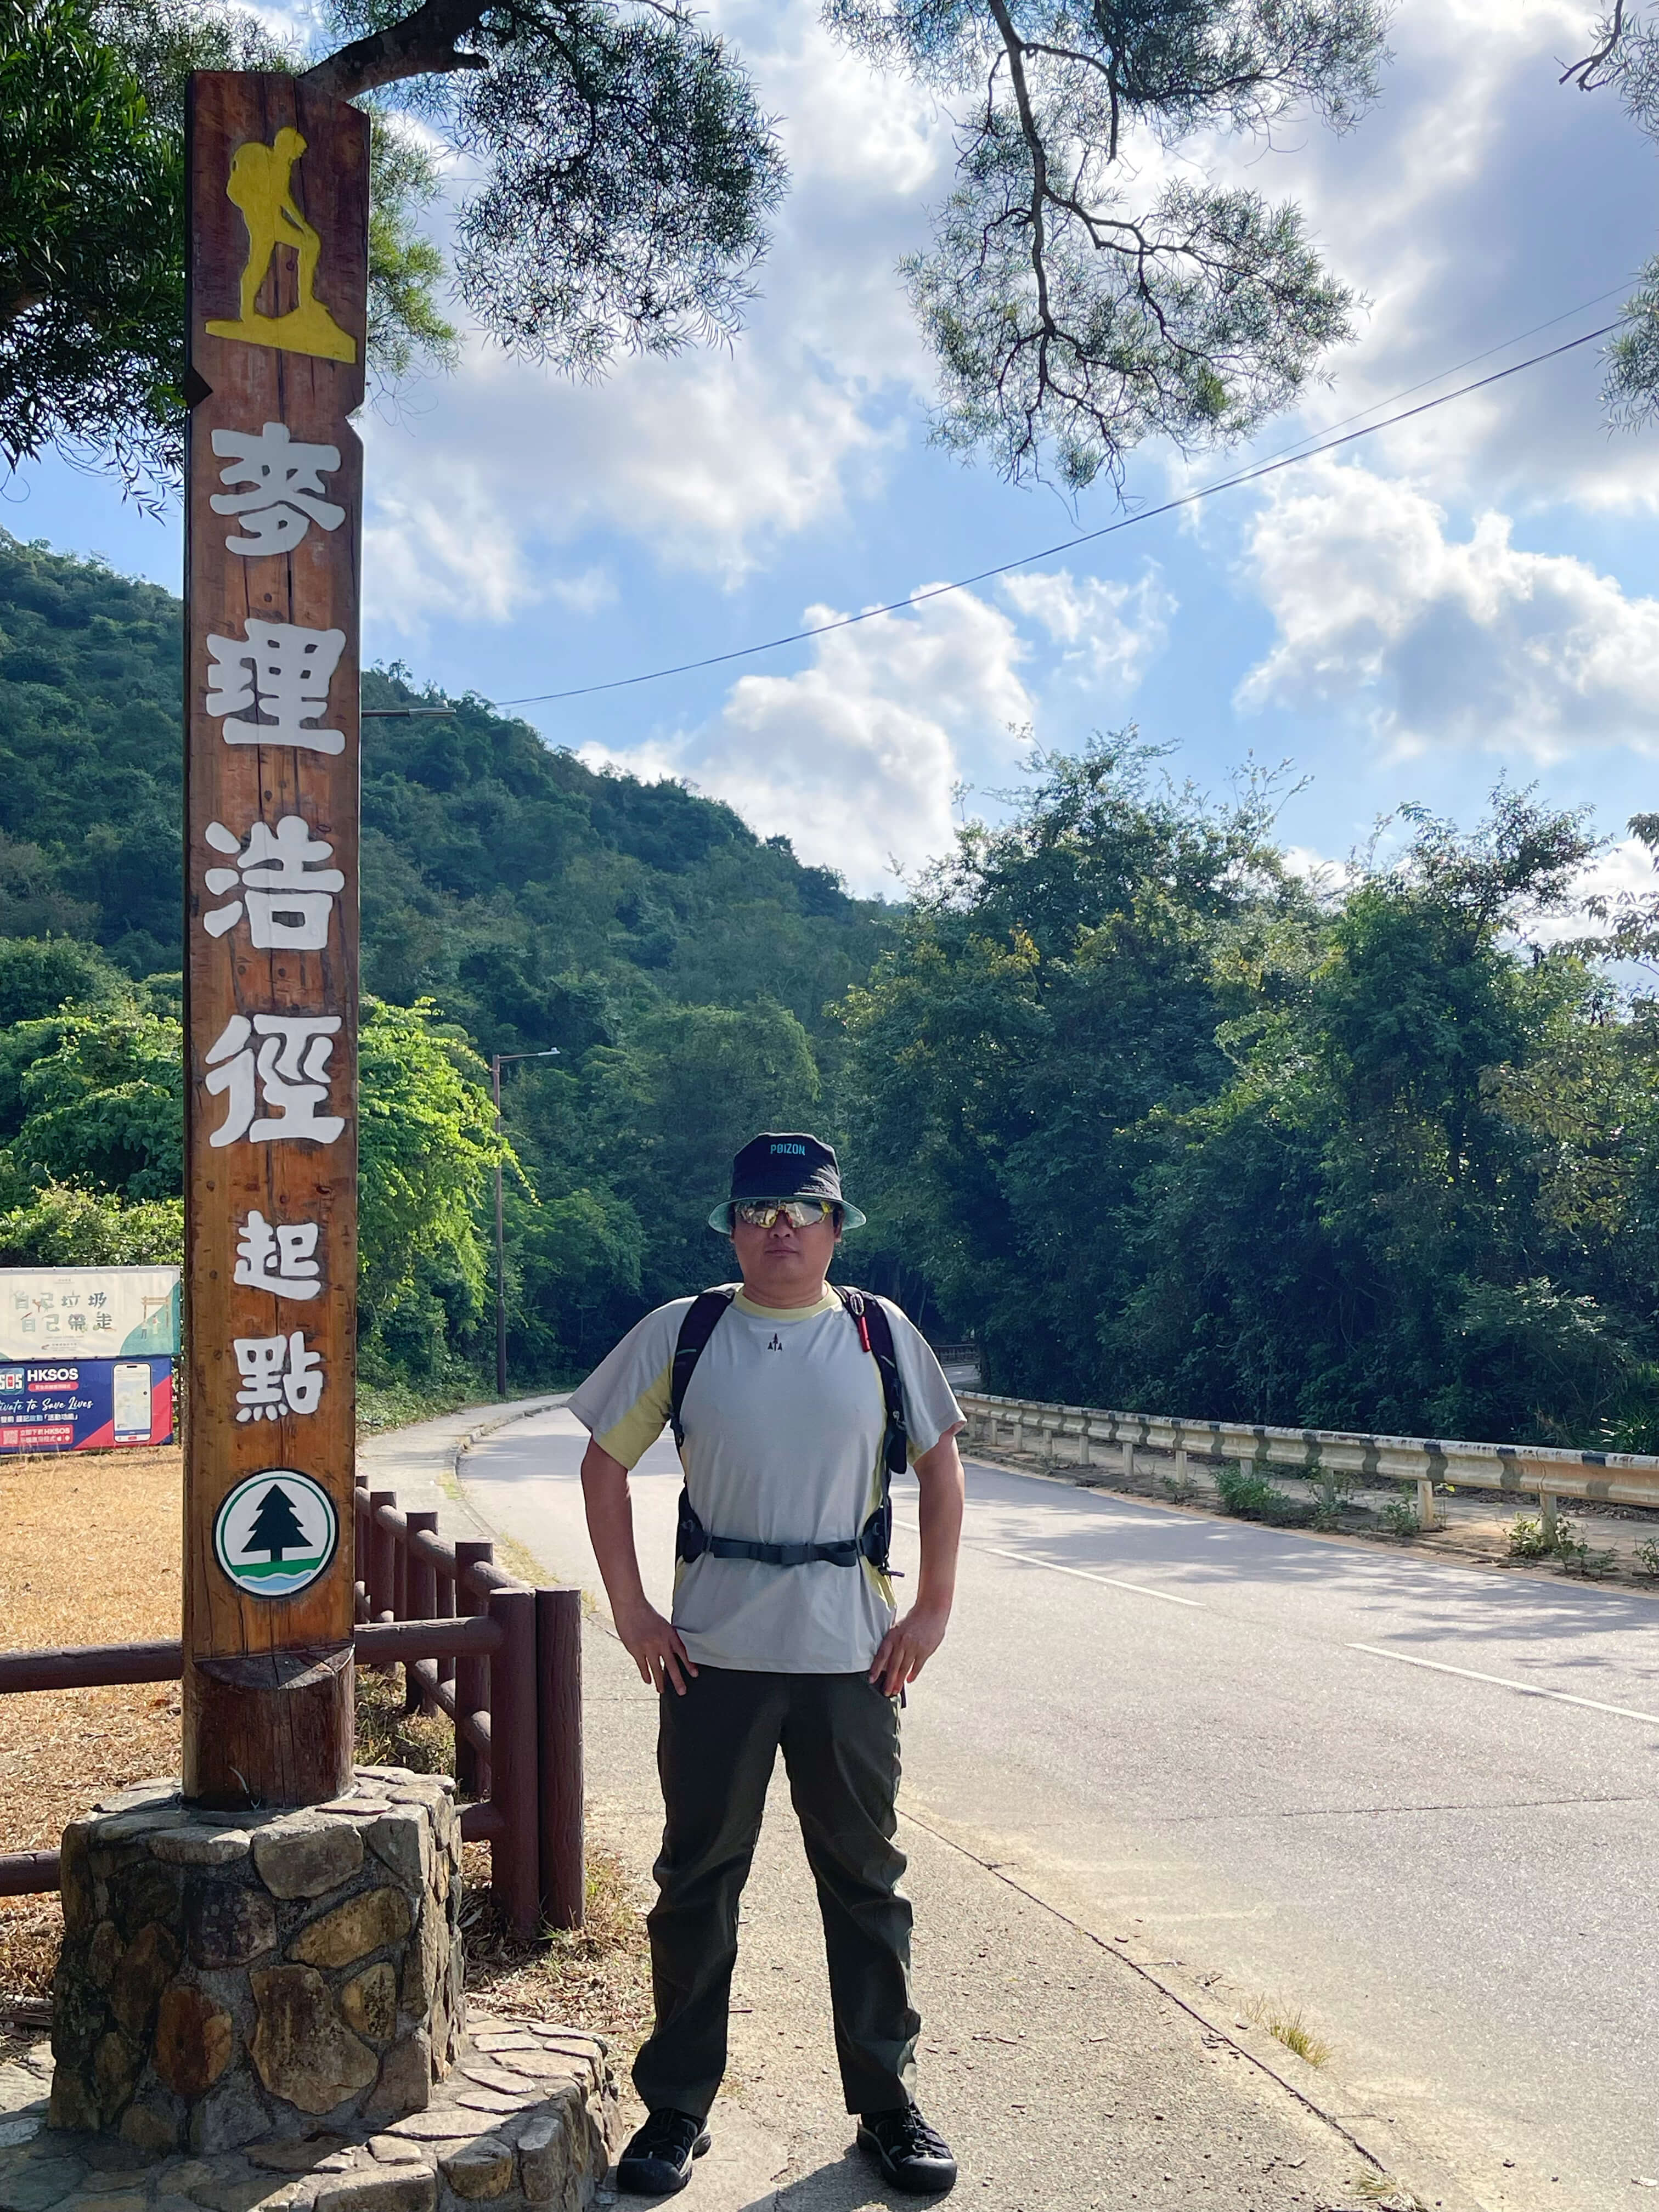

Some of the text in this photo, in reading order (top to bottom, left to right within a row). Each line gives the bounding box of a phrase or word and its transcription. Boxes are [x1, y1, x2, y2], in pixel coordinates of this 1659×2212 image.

[27, 1368, 79, 1381] HKSOS
[26, 1398, 38, 1413] to
[42, 1398, 66, 1411] Save
[67, 1396, 94, 1410] Lives
